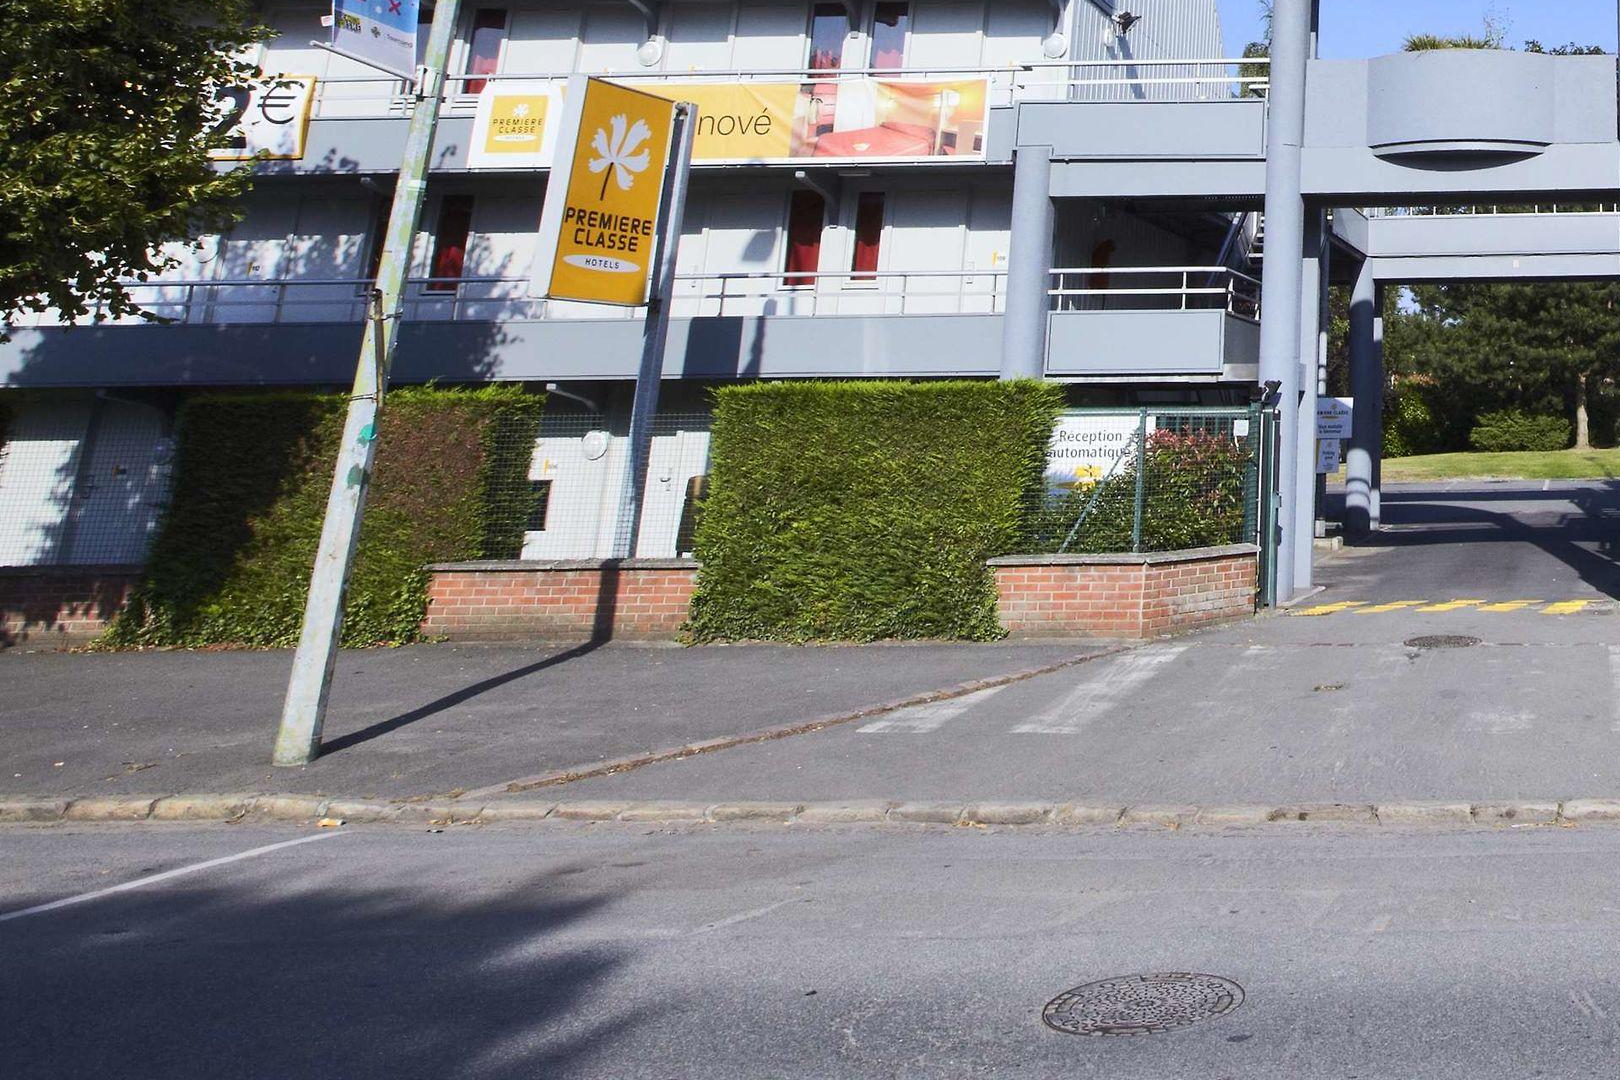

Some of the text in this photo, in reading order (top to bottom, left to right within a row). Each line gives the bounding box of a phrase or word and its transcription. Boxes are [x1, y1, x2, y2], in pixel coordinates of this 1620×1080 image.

[493, 118, 543, 126] PREMIERE
[564, 207, 653, 237] PREMIERE
[573, 228, 639, 252] CLASSE
[585, 258, 620, 269] HOTELS
